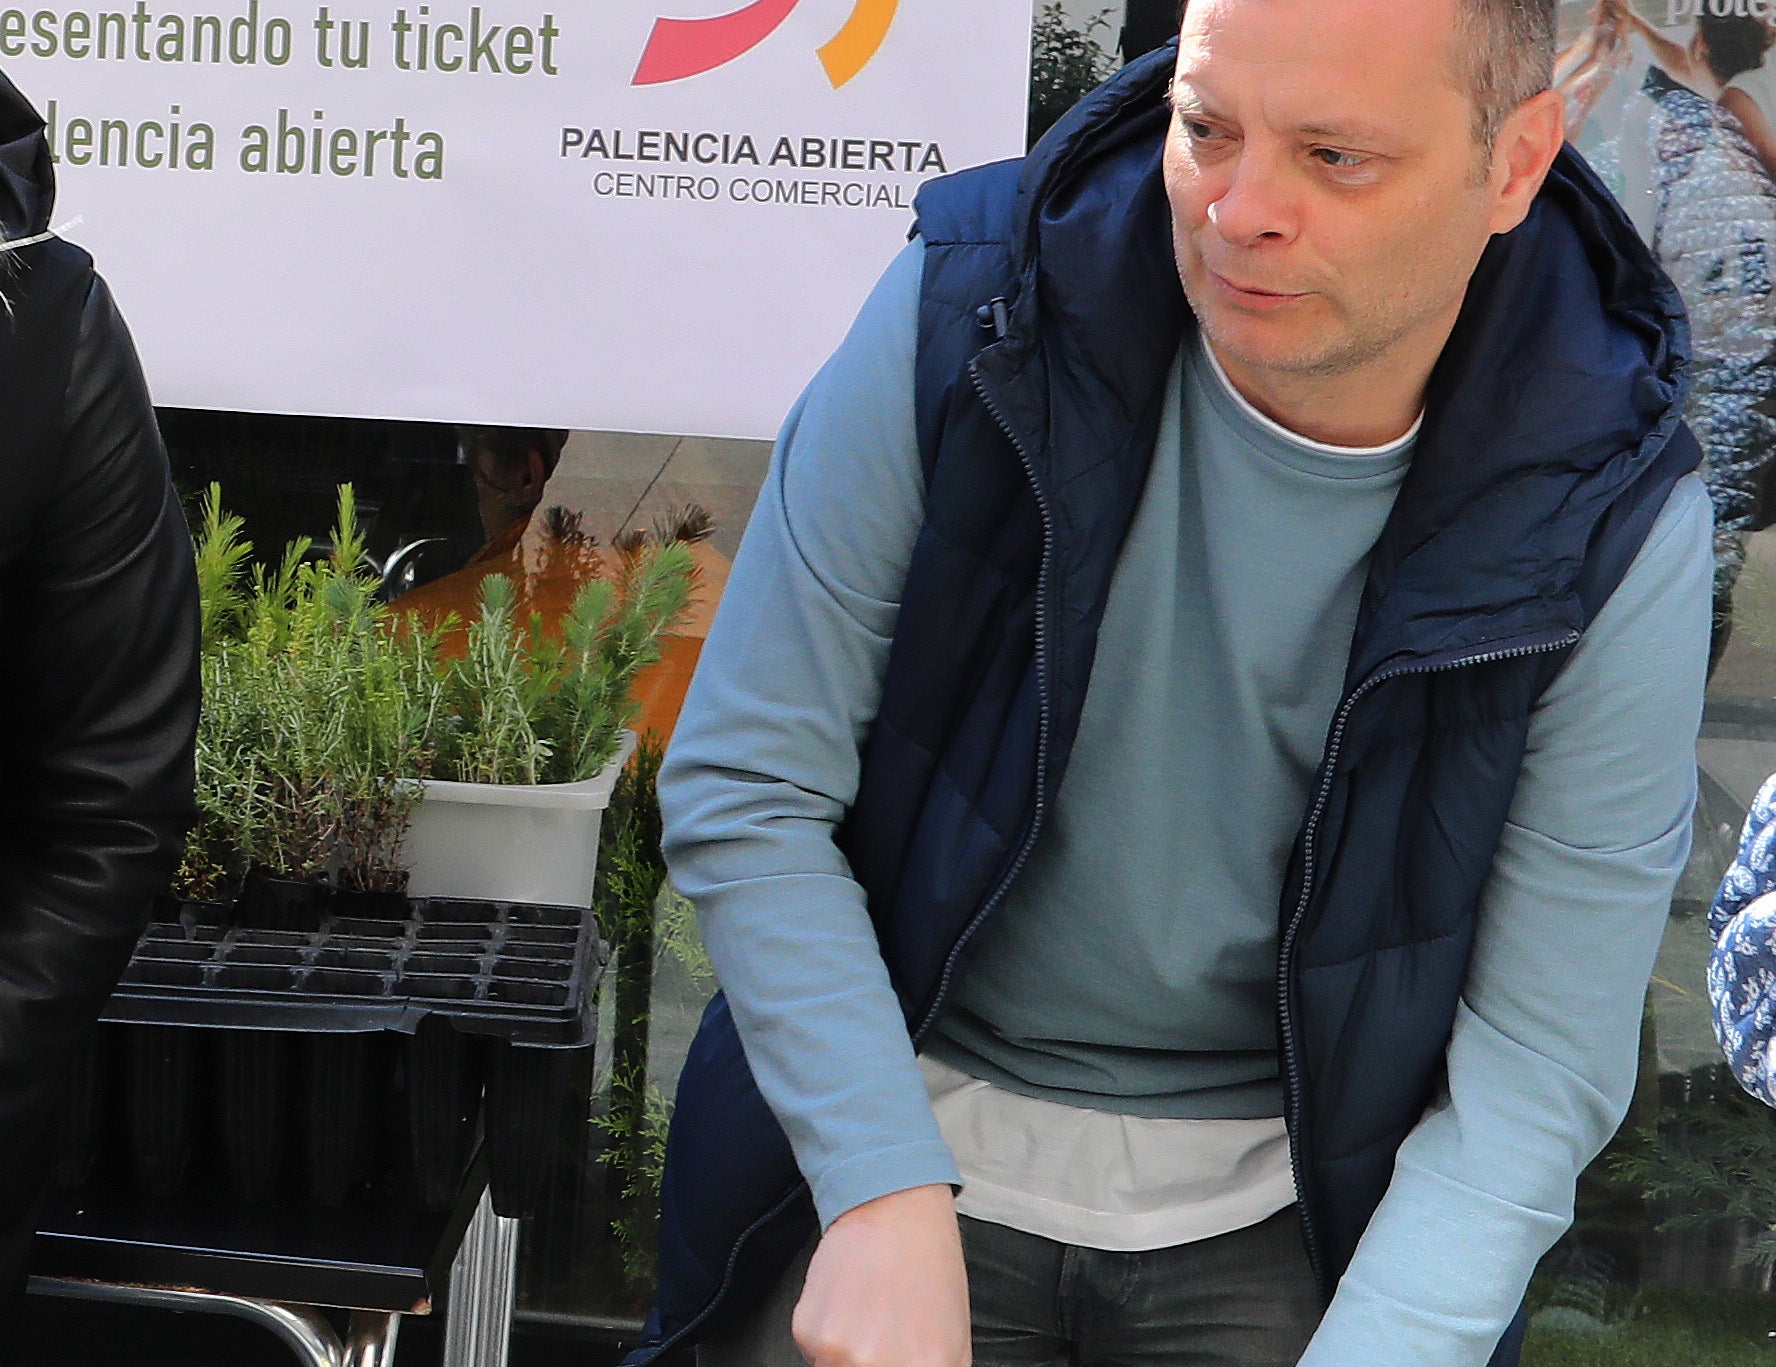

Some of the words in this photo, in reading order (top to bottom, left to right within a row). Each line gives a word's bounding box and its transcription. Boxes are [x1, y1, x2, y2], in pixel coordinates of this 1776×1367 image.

[314, 5, 370, 70] tu
[391, 7, 561, 77] ticket
[46, 99, 216, 172] lencia
[239, 107, 446, 179] abierta
[560, 127, 760, 166] PALENCIA
[768, 136, 947, 174] ABIERTA
[593, 172, 721, 201] CENTRO
[728, 177, 910, 209] COMERCIAL
